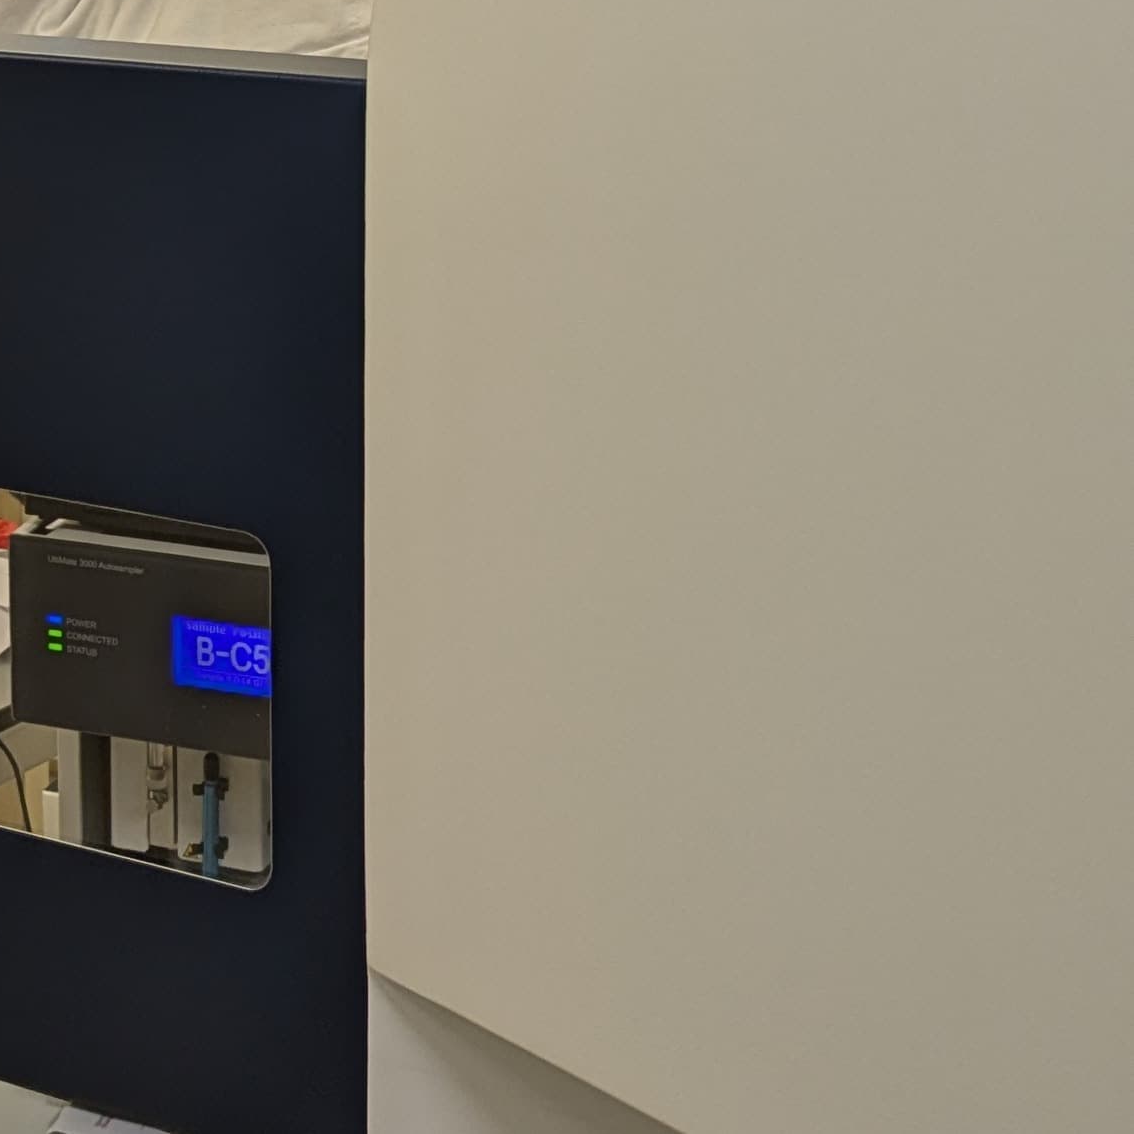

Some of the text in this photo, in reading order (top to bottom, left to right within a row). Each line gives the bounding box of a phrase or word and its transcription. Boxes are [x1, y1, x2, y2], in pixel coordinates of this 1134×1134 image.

[66, 617, 97, 629] POWER
[66, 632, 119, 646] CONNECTED
[67, 645, 98, 658] STATUS
[196, 635, 269, 675] B-C5
